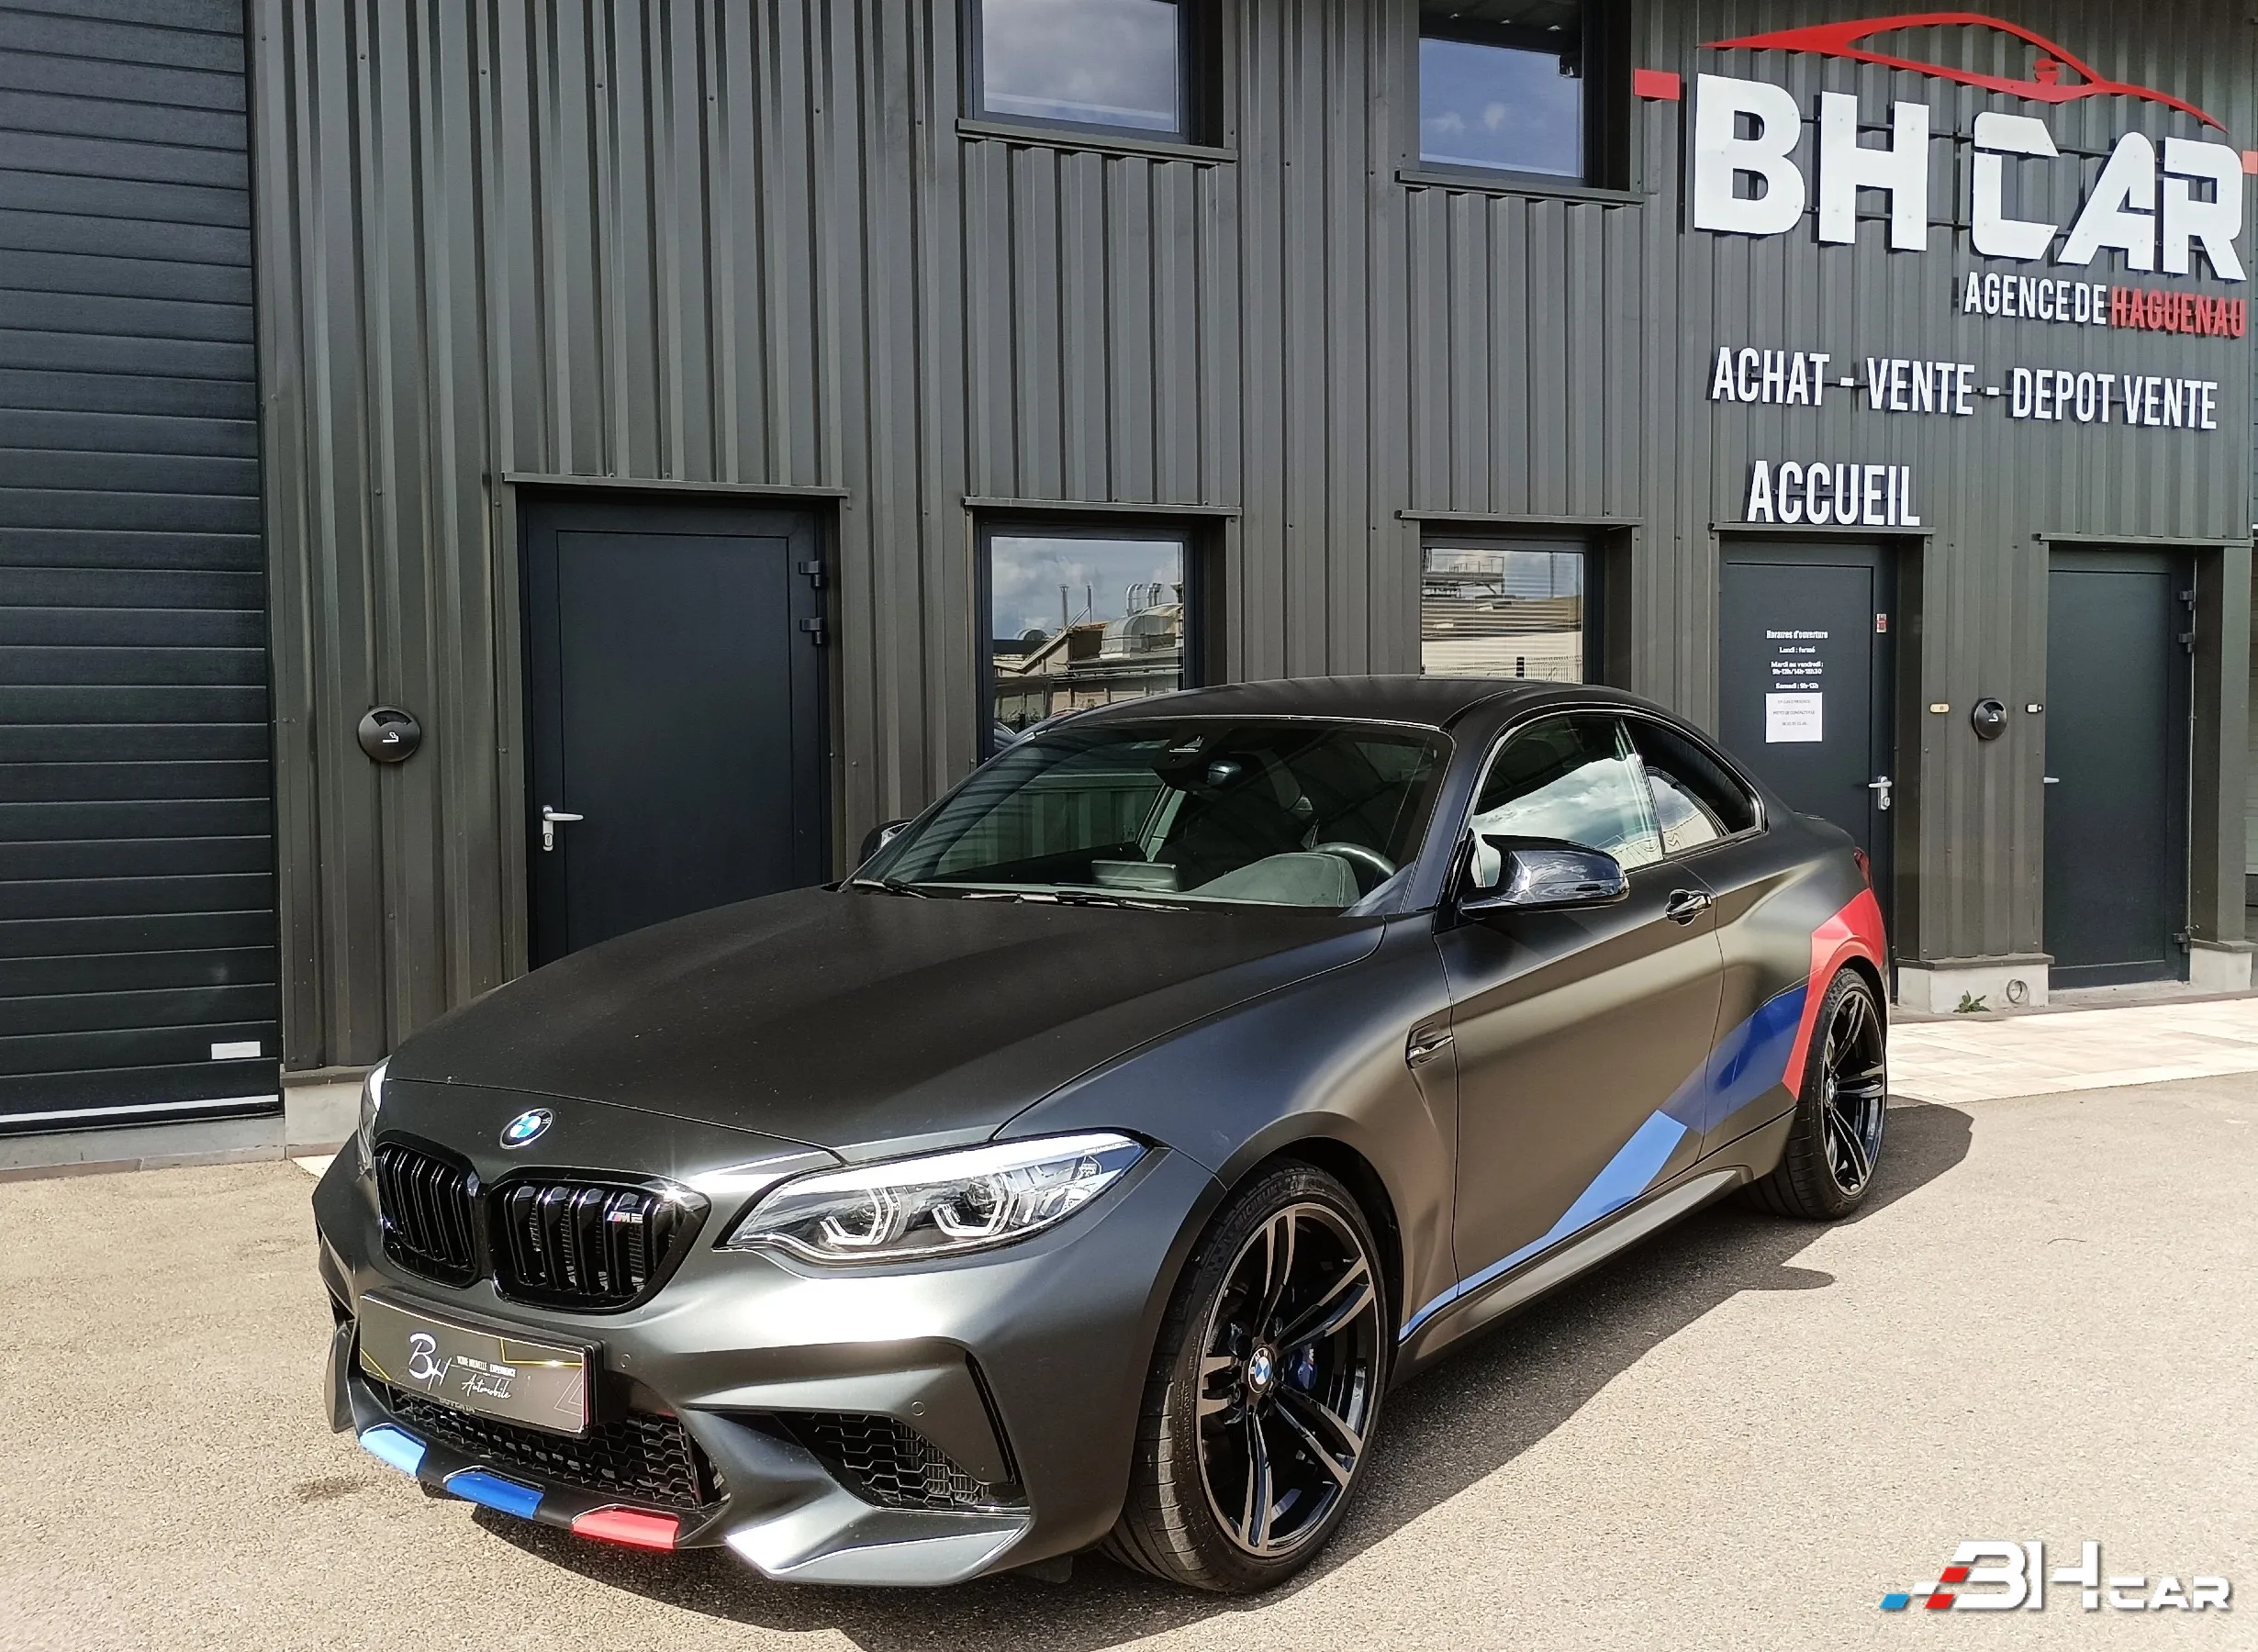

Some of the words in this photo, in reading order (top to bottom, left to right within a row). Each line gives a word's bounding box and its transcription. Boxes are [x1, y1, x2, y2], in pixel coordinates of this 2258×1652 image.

[1694, 73, 1929, 251] BH
[1972, 111, 2246, 280] CAR
[1964, 271, 2070, 321] AGENCE
[2074, 282, 2107, 325] DE
[2111, 285, 2246, 338] HAGUENAU
[1711, 346, 1830, 406] ACHAT
[1867, 357, 1974, 415] VENTE
[2013, 367, 2115, 423] DEPOT
[2124, 374, 2218, 430] VENTE
[1747, 460, 1920, 527] ACCUEIL
[461, 1373, 512, 1398] Automobile
